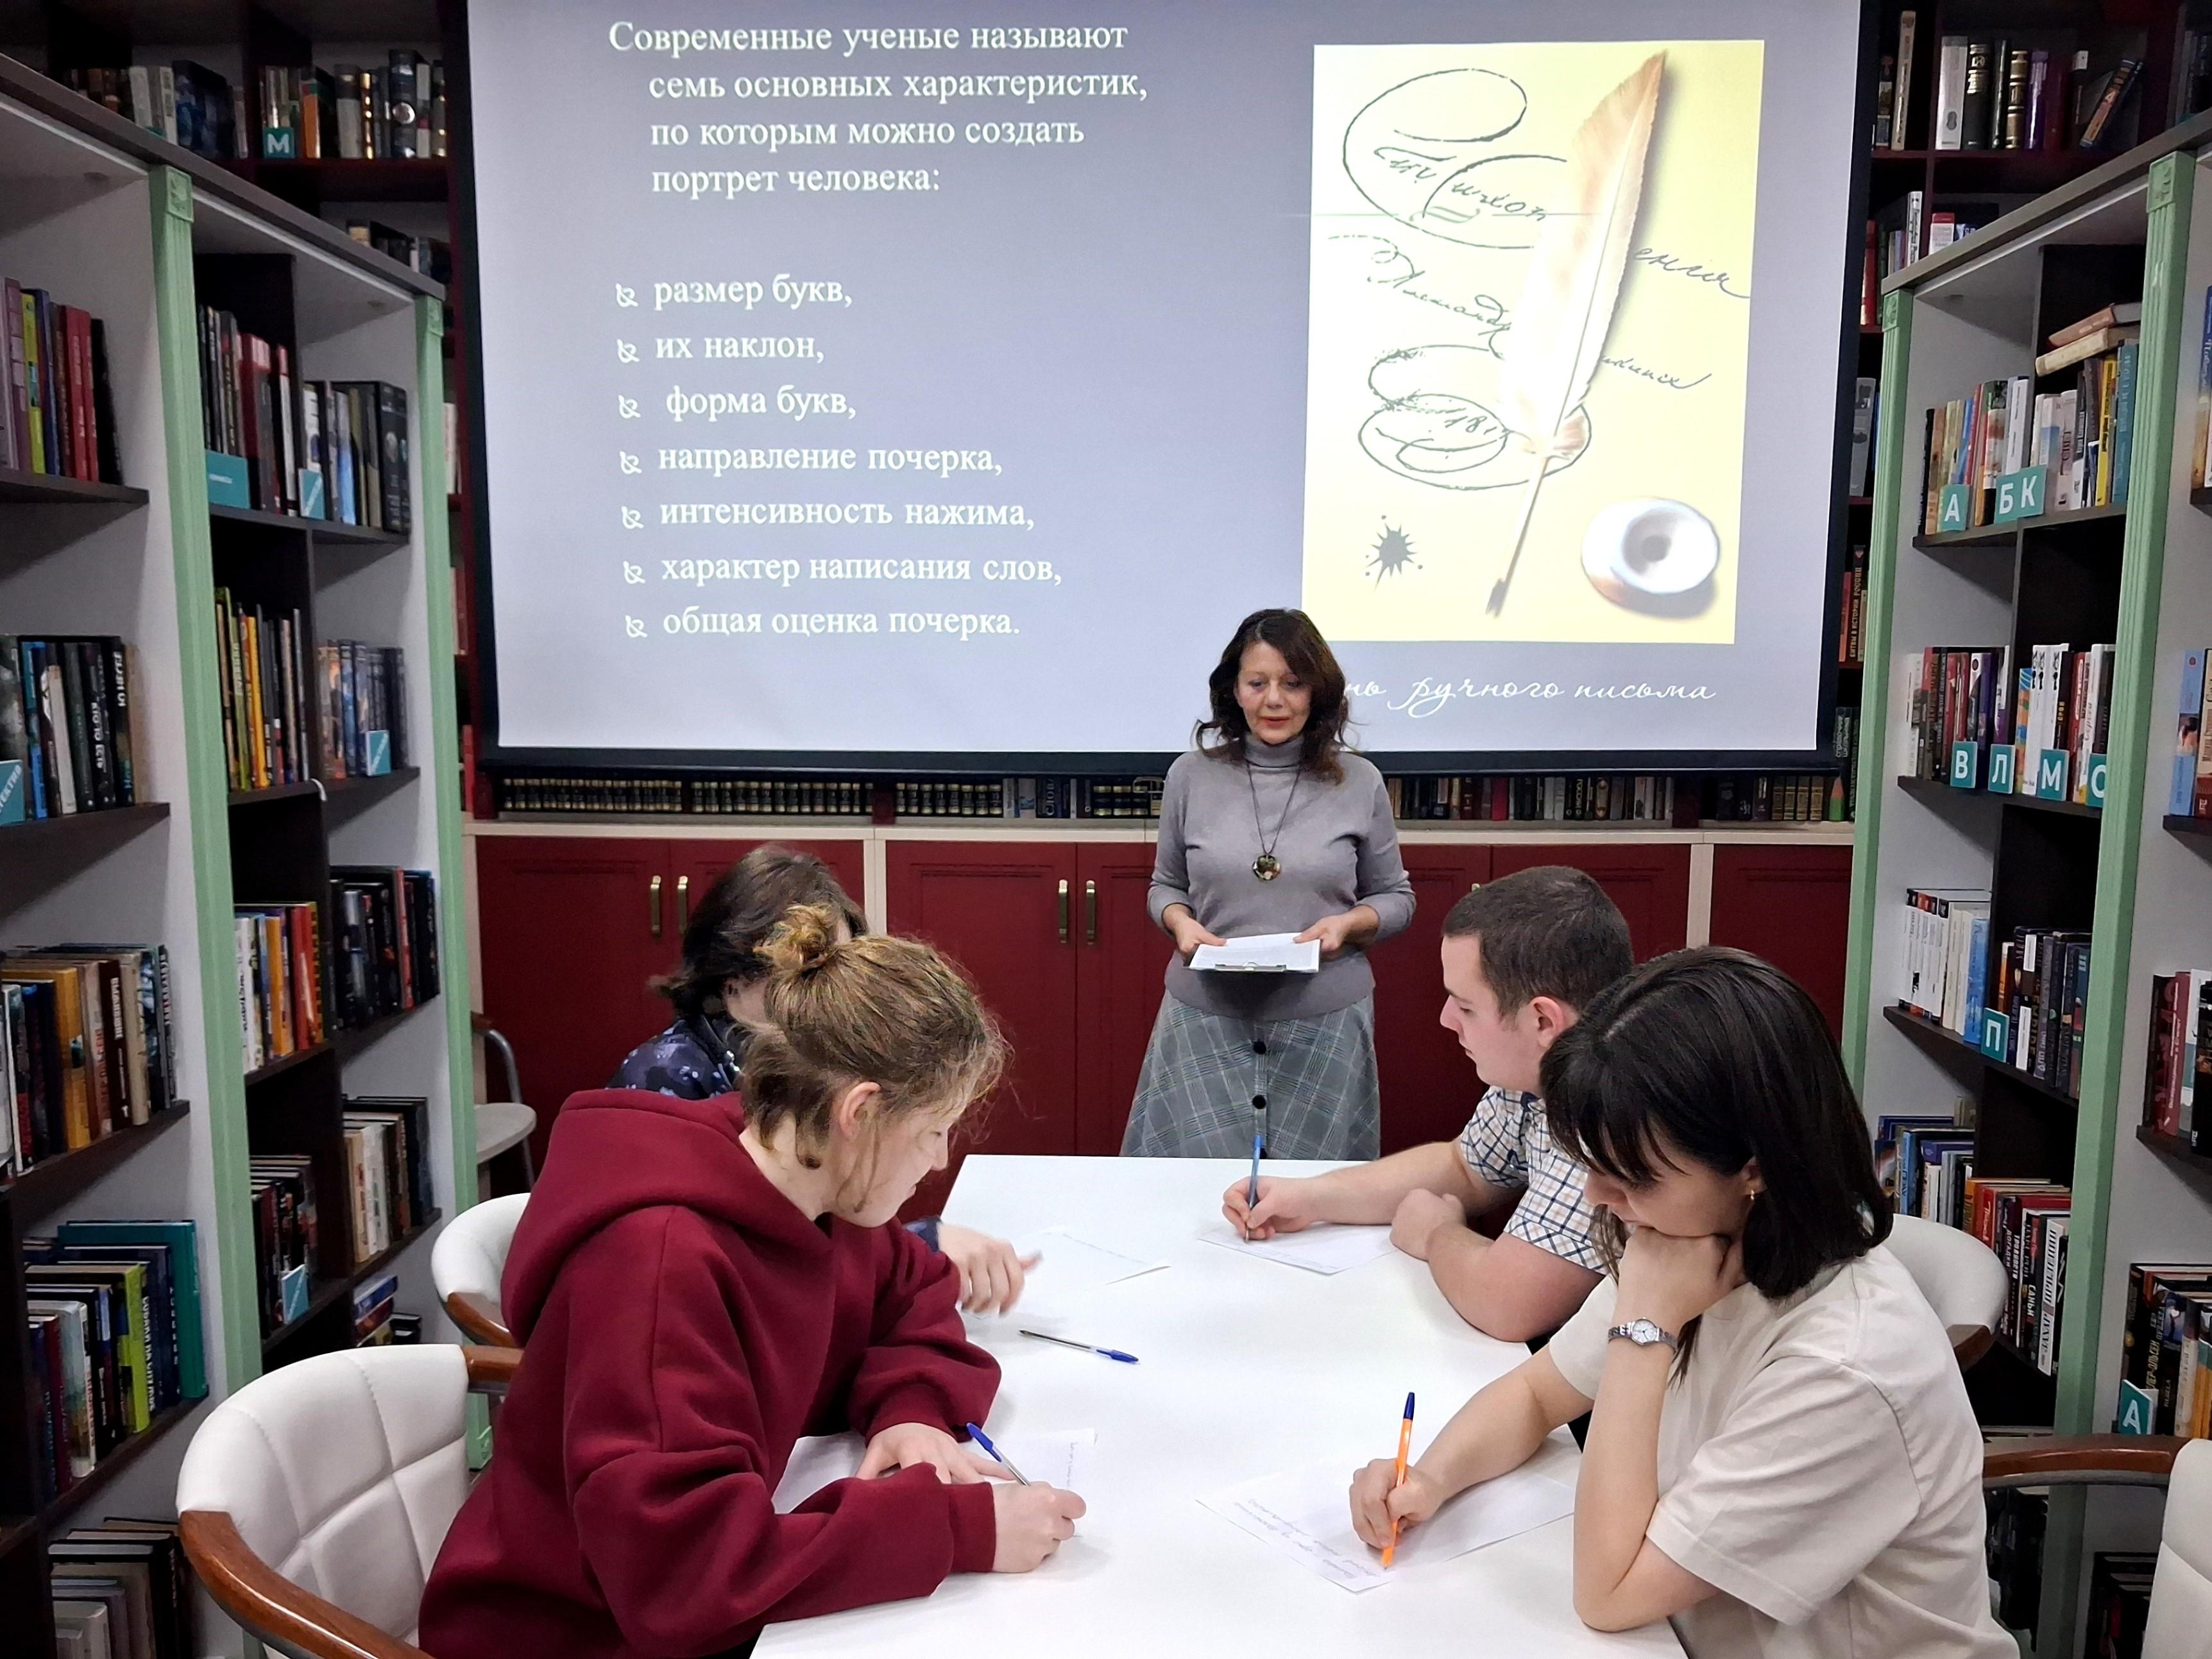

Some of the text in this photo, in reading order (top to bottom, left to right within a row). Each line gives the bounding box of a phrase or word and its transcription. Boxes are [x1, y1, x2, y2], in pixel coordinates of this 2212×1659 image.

[608, 21, 1129, 59] Современные ученые называют
[649, 74, 1148, 105] семь основных характеристик,
[266, 134, 289, 154] М
[651, 121, 1085, 153] по которым можно создать
[652, 168, 940, 201] портрет человека:
[654, 273, 853, 312] размер букв,
[656, 337, 824, 364] их наклон,
[666, 384, 856, 422] форма букв,
[658, 448, 1003, 479] направление почерка,
[659, 503, 1035, 531] интенсивность нажима,
[1943, 493, 1961, 523] А
[661, 558, 1062, 588] характер написания слов,
[663, 605, 1020, 642] общая оценка почерка.
[1344, 677, 1717, 719] нь ручного письма
[1955, 751, 1968, 779] В
[1991, 754, 2007, 785] Л
[2041, 760, 2063, 792] М
[1987, 1019, 2002, 1053] П
[2123, 1398, 2142, 1434] А
